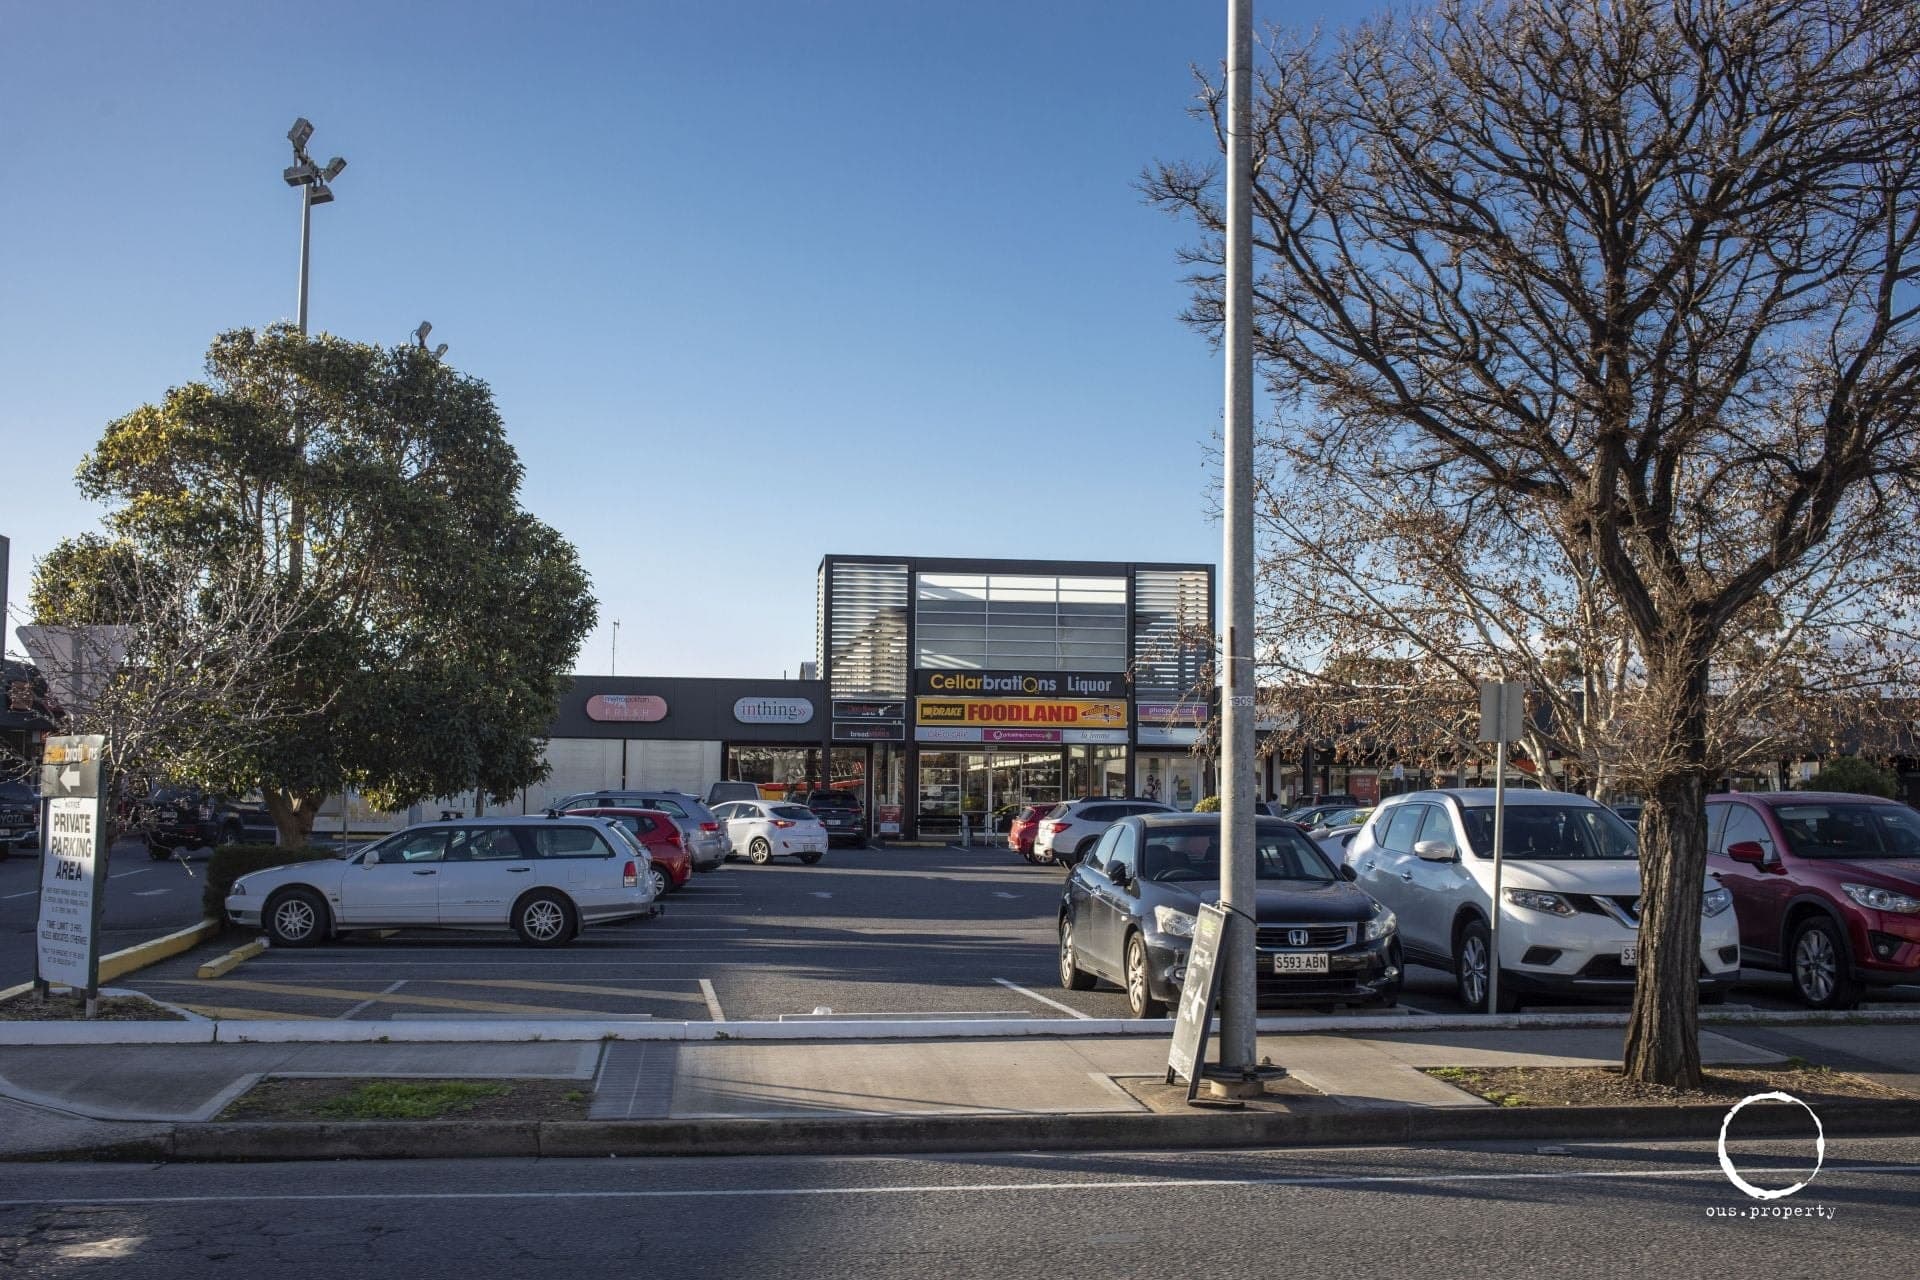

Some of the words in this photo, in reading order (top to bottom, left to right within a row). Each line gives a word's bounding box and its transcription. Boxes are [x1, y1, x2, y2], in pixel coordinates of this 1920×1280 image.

[1067, 676, 1112, 695] Liquor
[933, 706, 963, 717] DRAKE
[967, 704, 1078, 722] FOODLAND
[0, 814, 24, 824] YOTA
[54, 813, 91, 834] PRIVATE
[52, 836, 92, 857] PARKING
[56, 861, 82, 881] AREA
